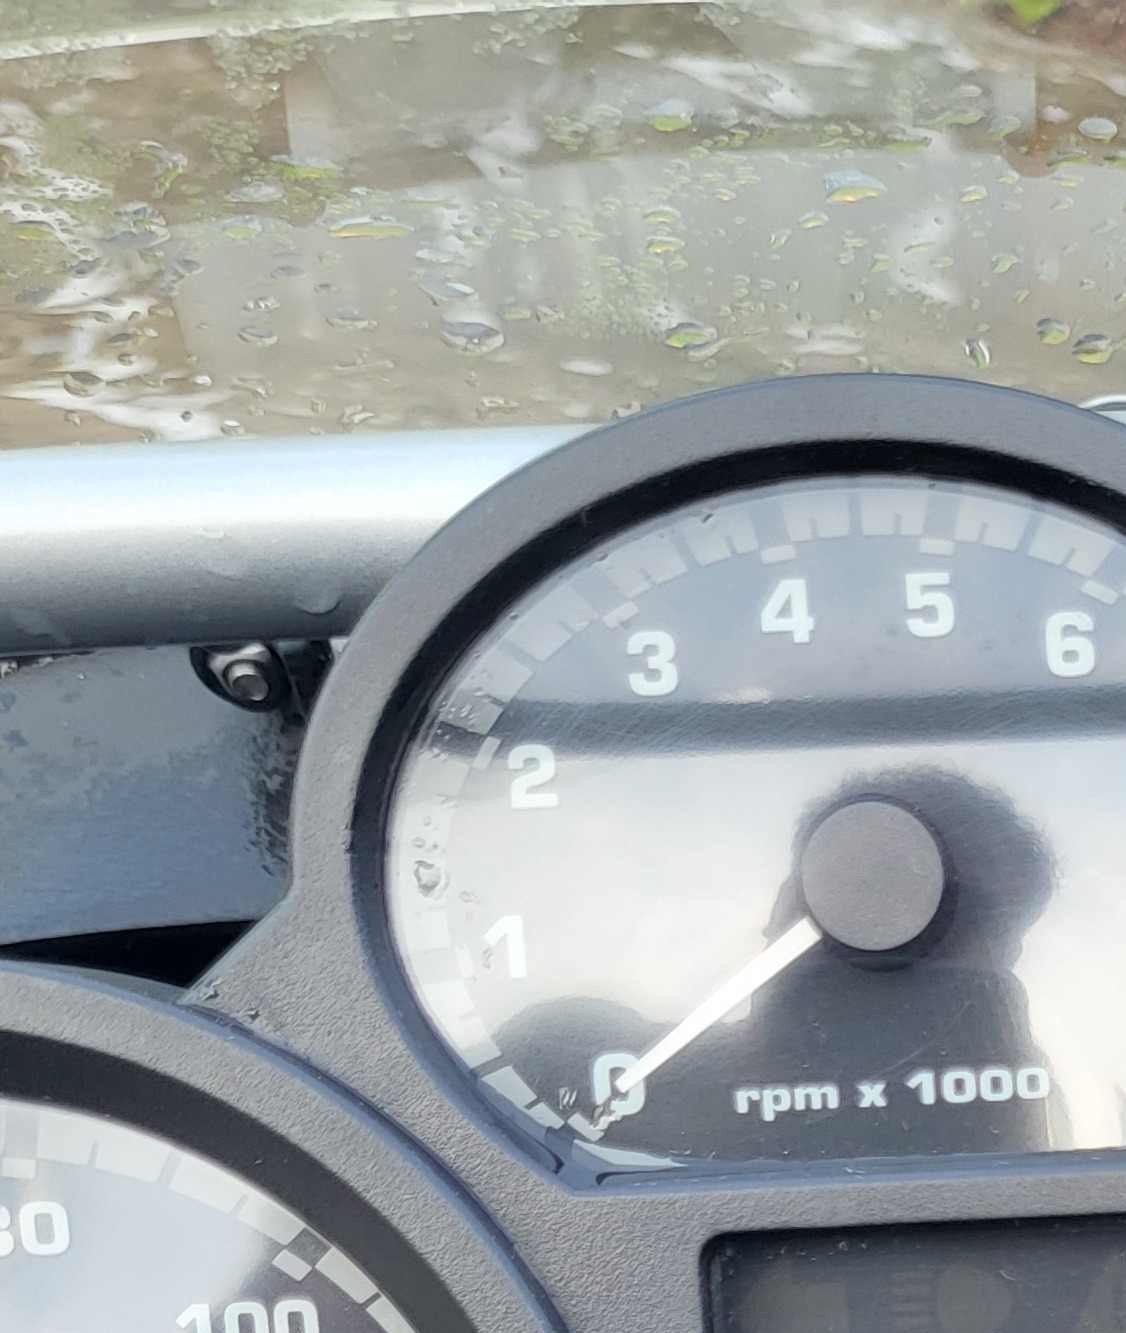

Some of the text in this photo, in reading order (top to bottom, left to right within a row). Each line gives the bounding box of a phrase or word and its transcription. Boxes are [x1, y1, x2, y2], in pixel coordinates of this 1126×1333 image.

[761, 579, 814, 643] 4
[905, 572, 954, 637] 5
[626, 631, 678, 696] 3
[1045, 611, 1095, 677] 6
[507, 744, 559, 809] 2
[484, 915, 527, 978] 1
[733, 1067, 1050, 1122] rpm x 1000
[0, 1201, 70, 1256] 0
